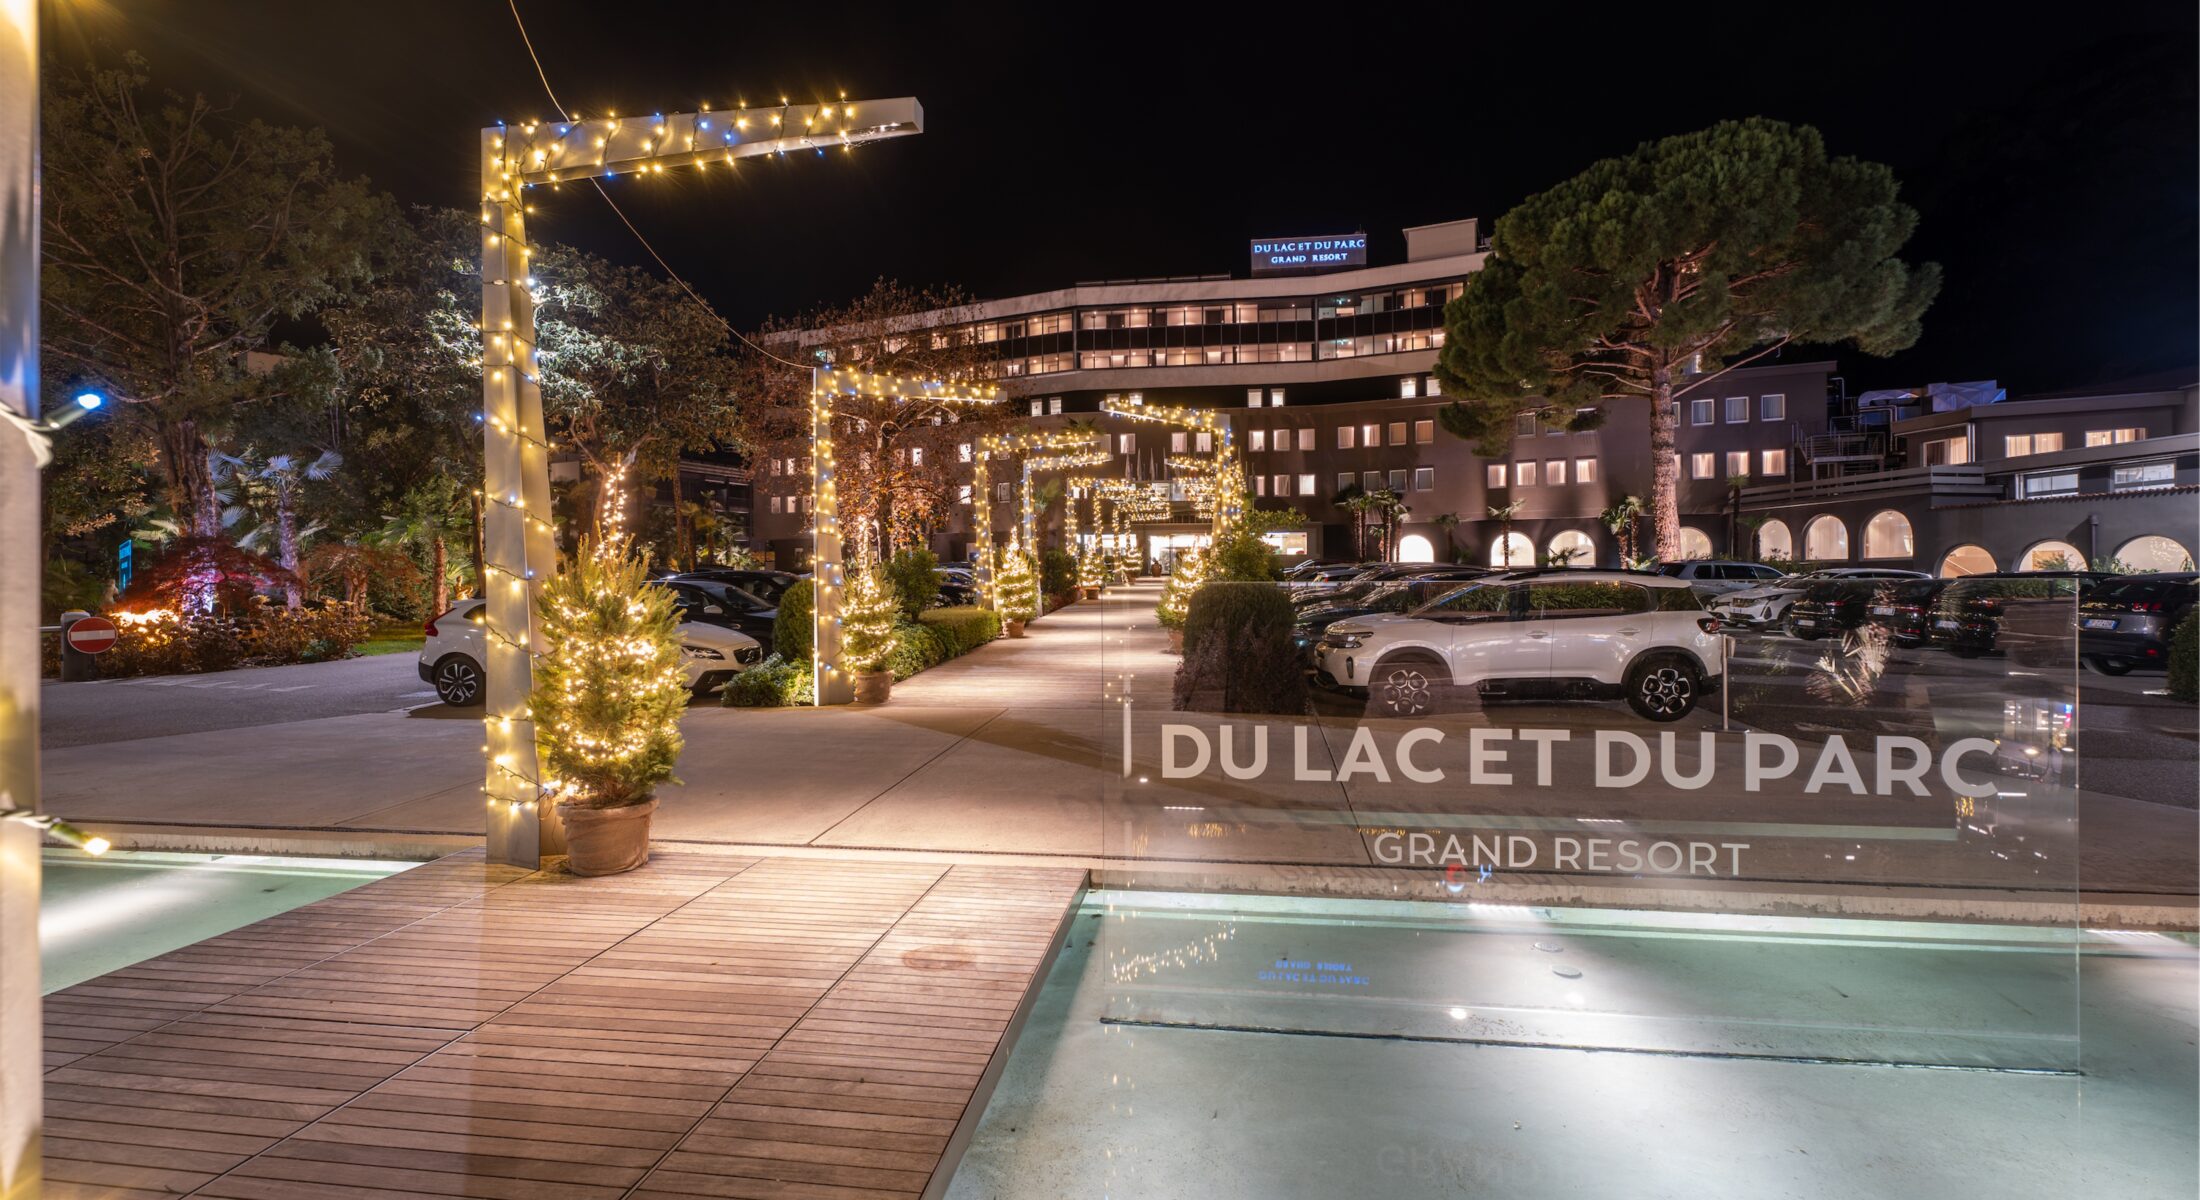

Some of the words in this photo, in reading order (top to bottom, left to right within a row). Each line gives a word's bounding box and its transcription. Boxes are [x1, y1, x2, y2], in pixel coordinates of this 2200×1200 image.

[1254, 244, 1271, 254] DU
[1274, 243, 1296, 252] LAC
[1298, 242, 1312, 251] ET
[1314, 241, 1331, 250] DU
[1334, 239, 1365, 249] PARC
[1271, 255, 1306, 264] GRAND
[1312, 253, 1348, 262] RESORT
[1161, 724, 1268, 780] DU
[1294, 725, 1446, 783] LAC
[1469, 728, 1571, 786] ET
[1594, 729, 1716, 790] DU
[1744, 731, 2000, 798] PARC
[1373, 832, 1538, 869] GRAND
[1553, 836, 1751, 877] RESORT
